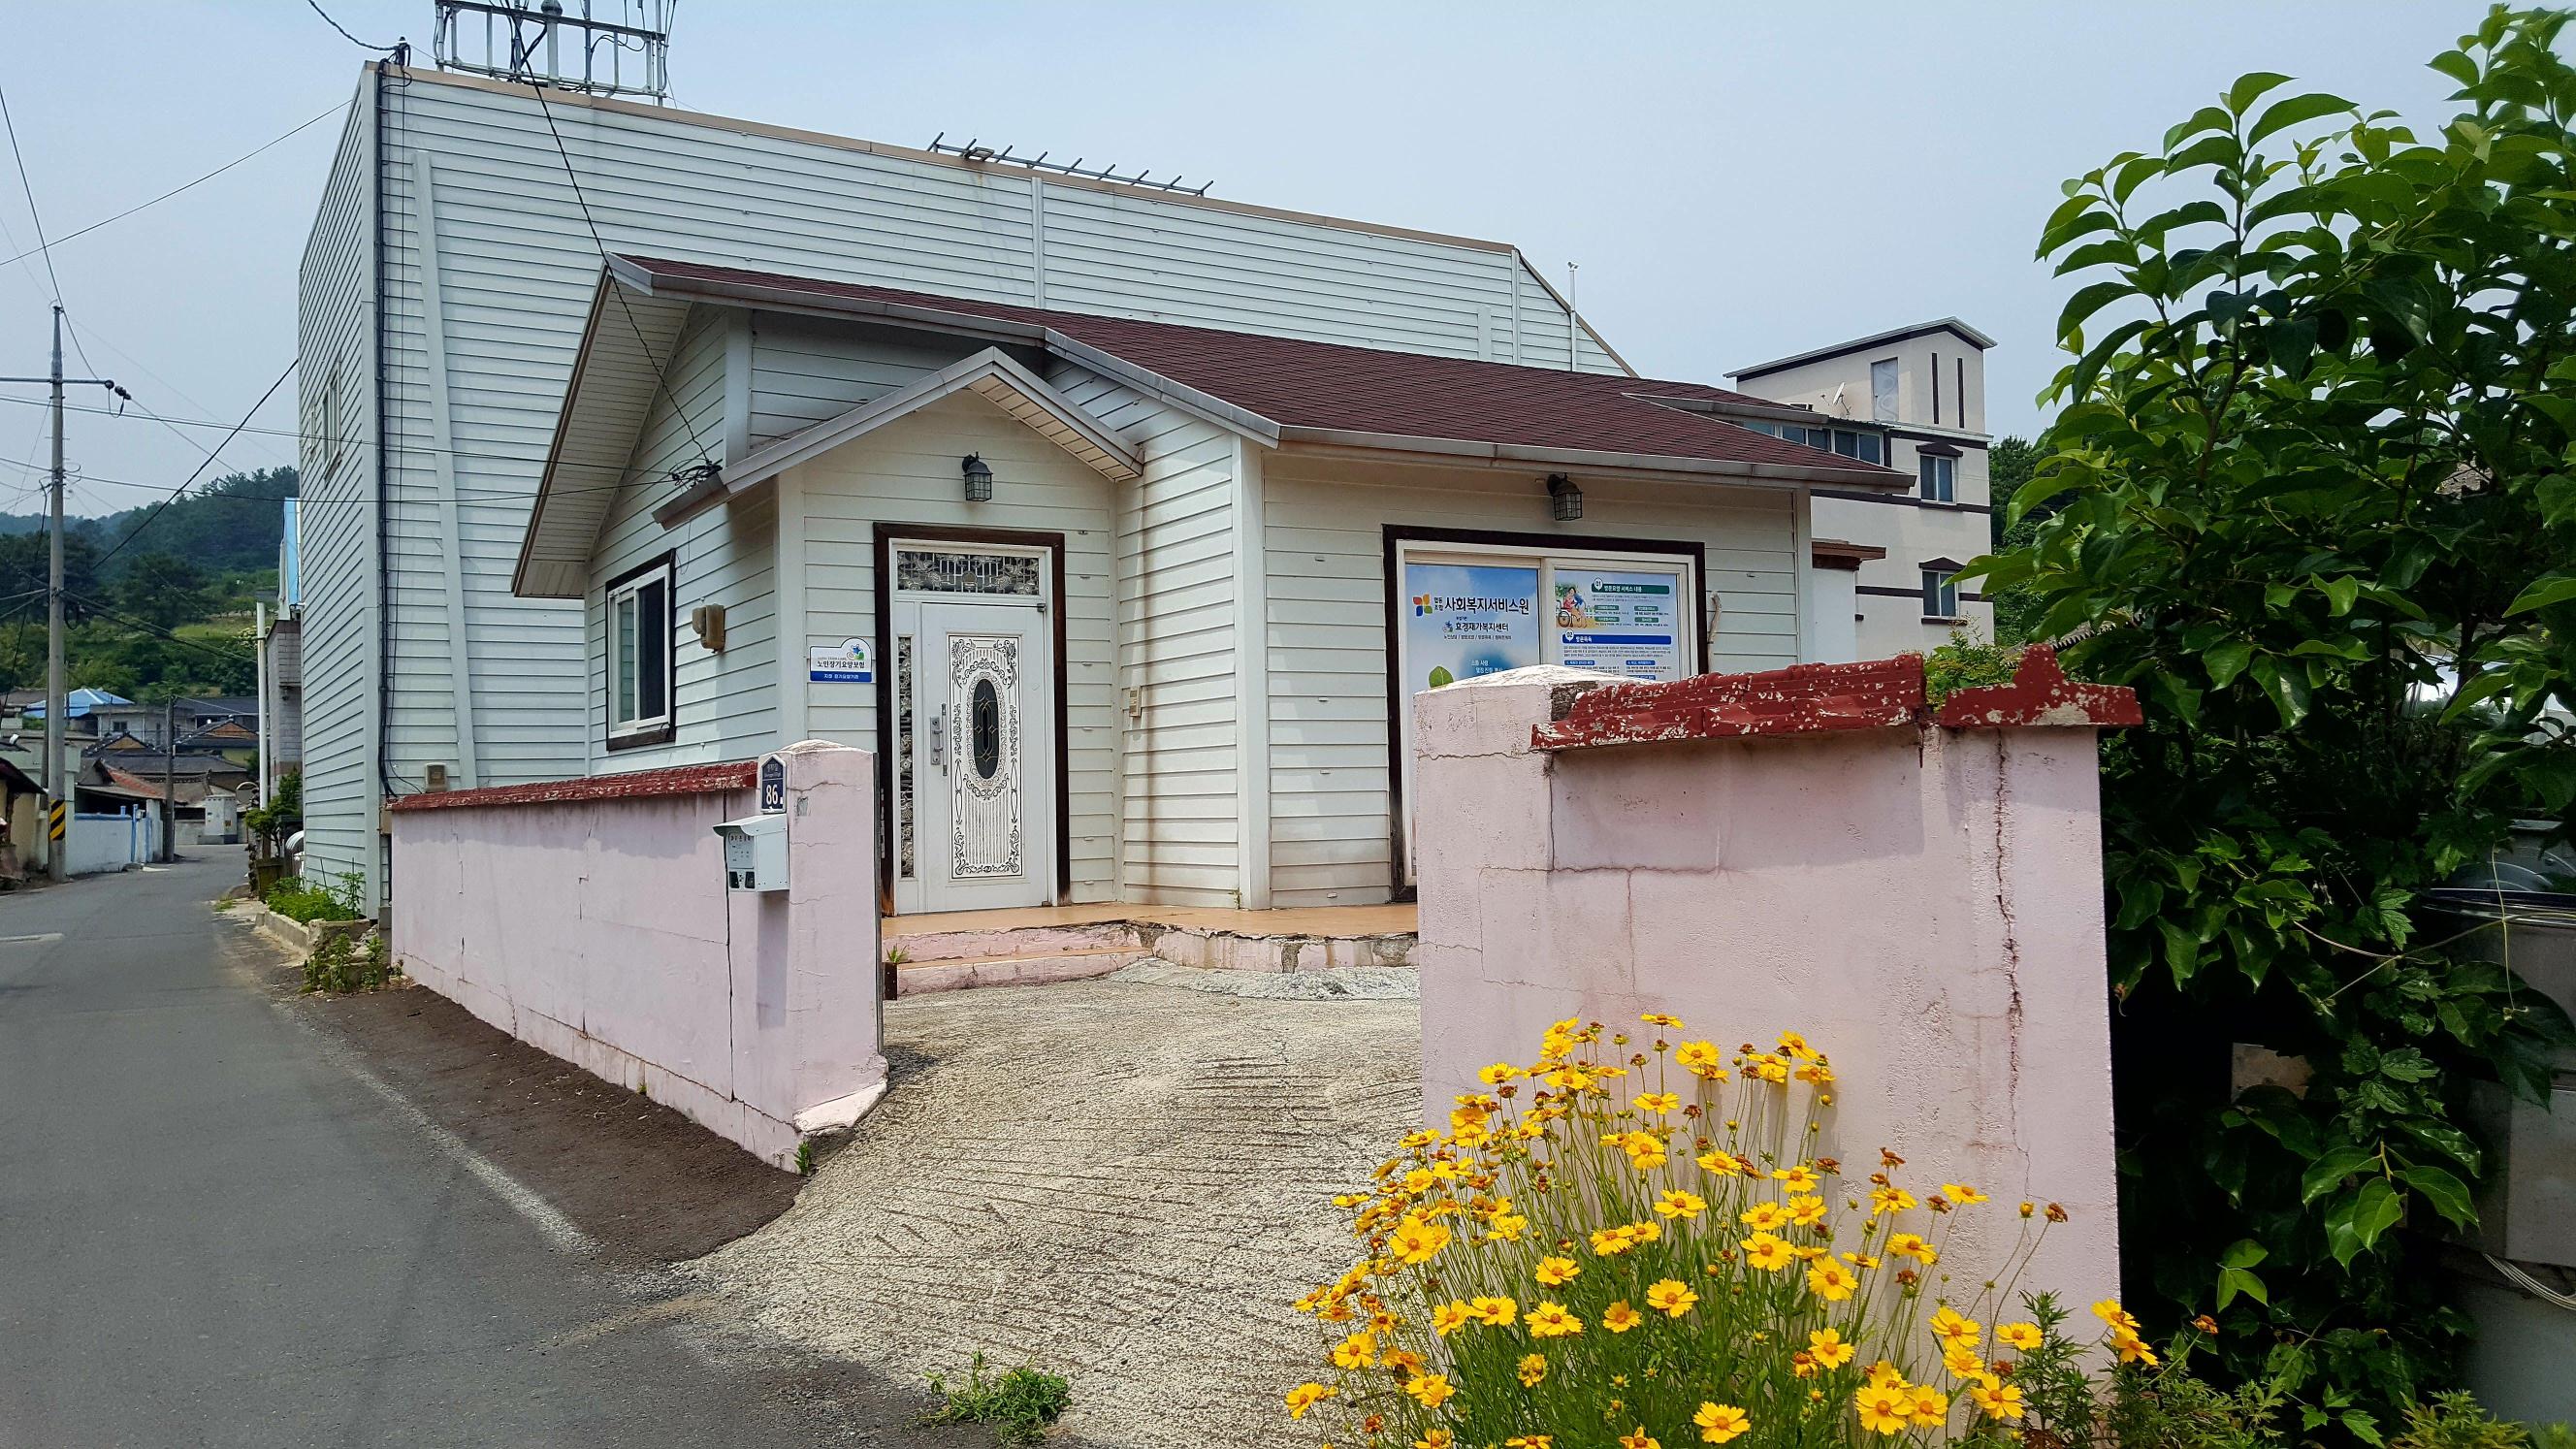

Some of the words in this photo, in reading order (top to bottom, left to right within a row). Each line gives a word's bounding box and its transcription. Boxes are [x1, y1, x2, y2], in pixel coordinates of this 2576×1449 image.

[1445, 596, 1530, 615] 사회복지서비스원
[817, 660, 865, 669] 노인장기요양보험
[765, 784, 779, 805] 86
